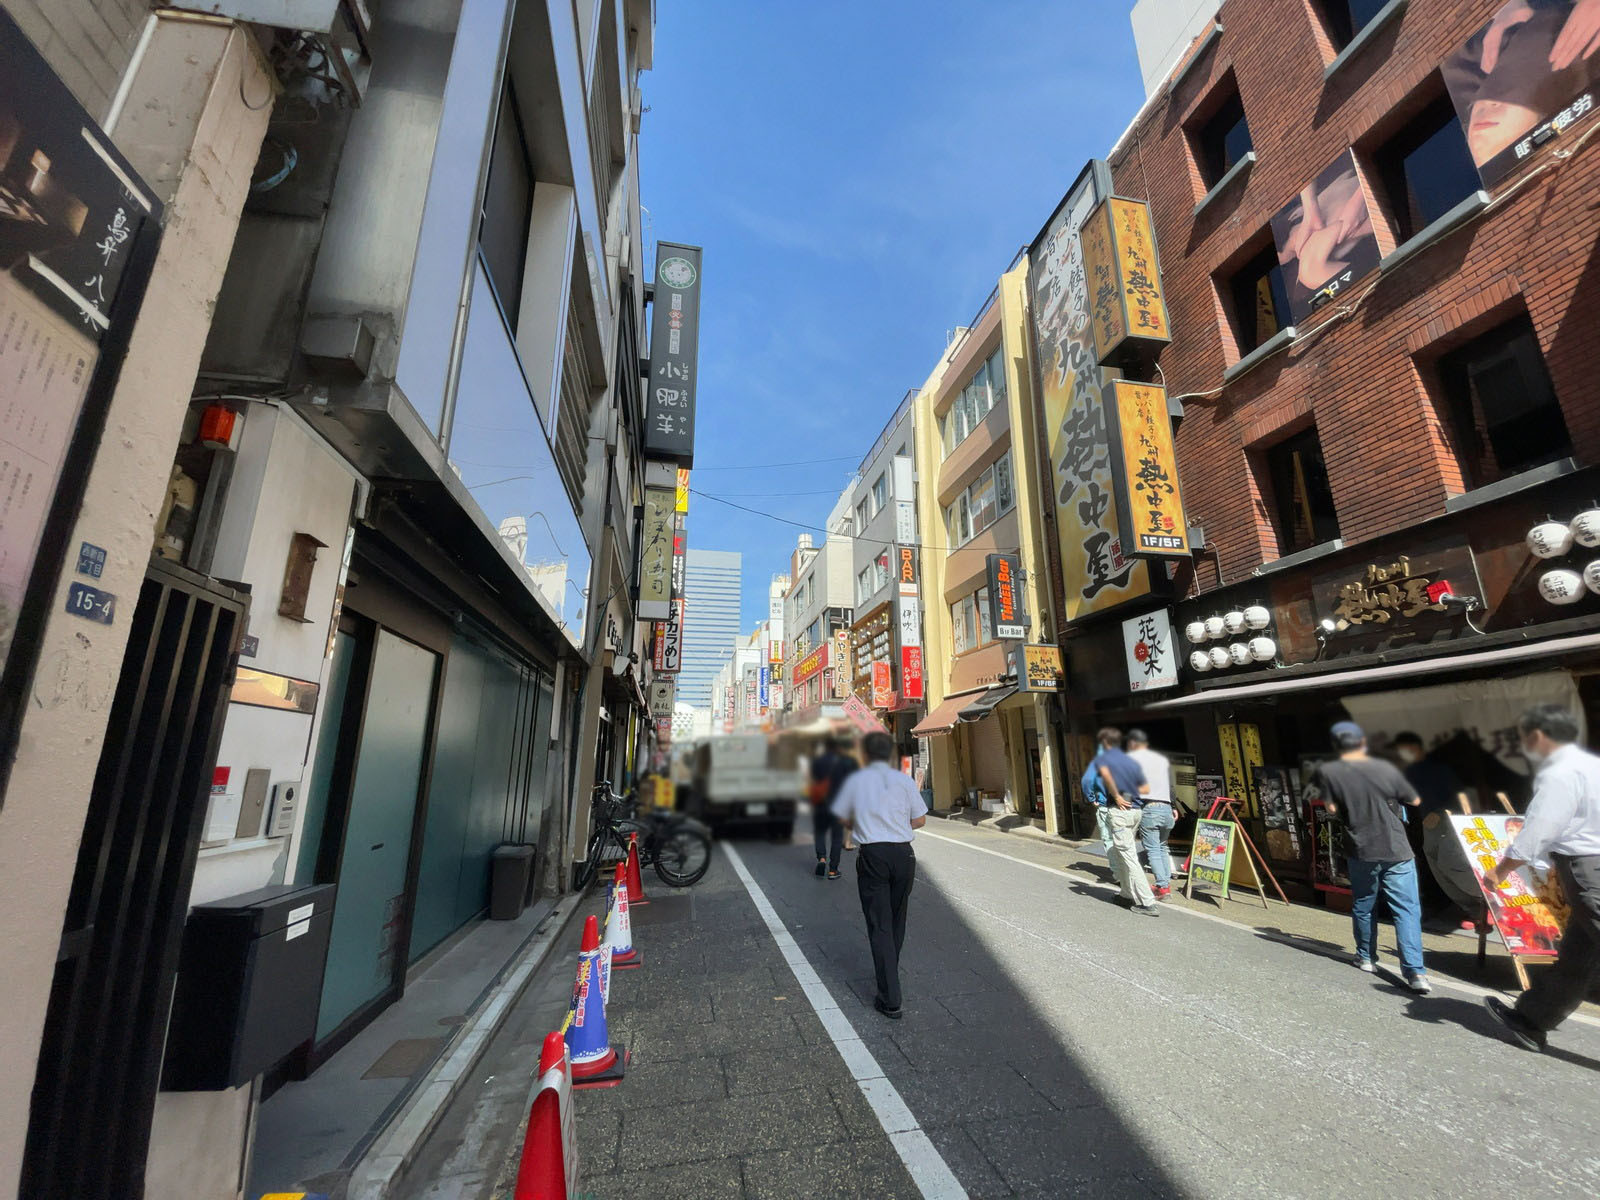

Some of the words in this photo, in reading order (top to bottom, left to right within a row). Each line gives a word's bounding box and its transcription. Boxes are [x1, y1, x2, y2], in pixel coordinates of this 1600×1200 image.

[656, 361, 680, 434] 小肥羊
[1136, 434, 1174, 534] 九州熱中屋
[1143, 535, 1181, 547] 1F/5F
[901, 549, 914, 583] BAR
[998, 559, 1009, 582] Bar
[76, 590, 112, 617] 15-4
[1001, 584, 1014, 621] THREE
[1138, 616, 1164, 678] 花水木
[1131, 682, 1140, 690] 2F
